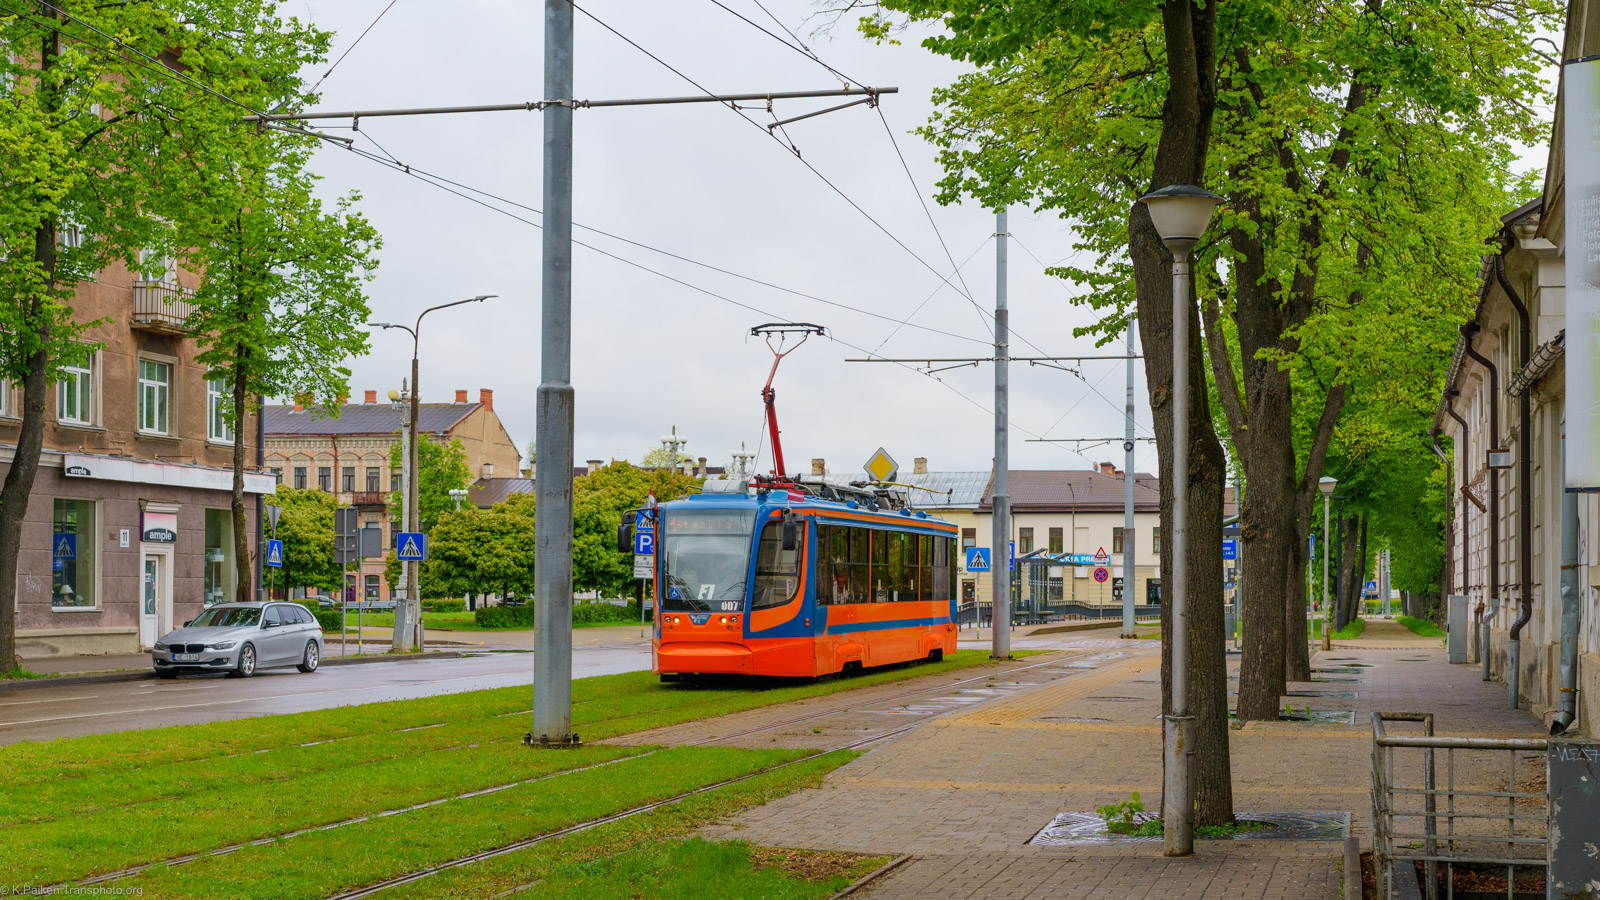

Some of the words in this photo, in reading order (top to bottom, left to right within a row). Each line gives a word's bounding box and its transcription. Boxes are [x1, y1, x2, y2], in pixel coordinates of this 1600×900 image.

[1572, 195, 1600, 206] Vizuāl
[70, 466, 87, 475] ample
[149, 529, 172, 542] ample
[640, 535, 652, 551] P
[721, 601, 738, 611] 007
